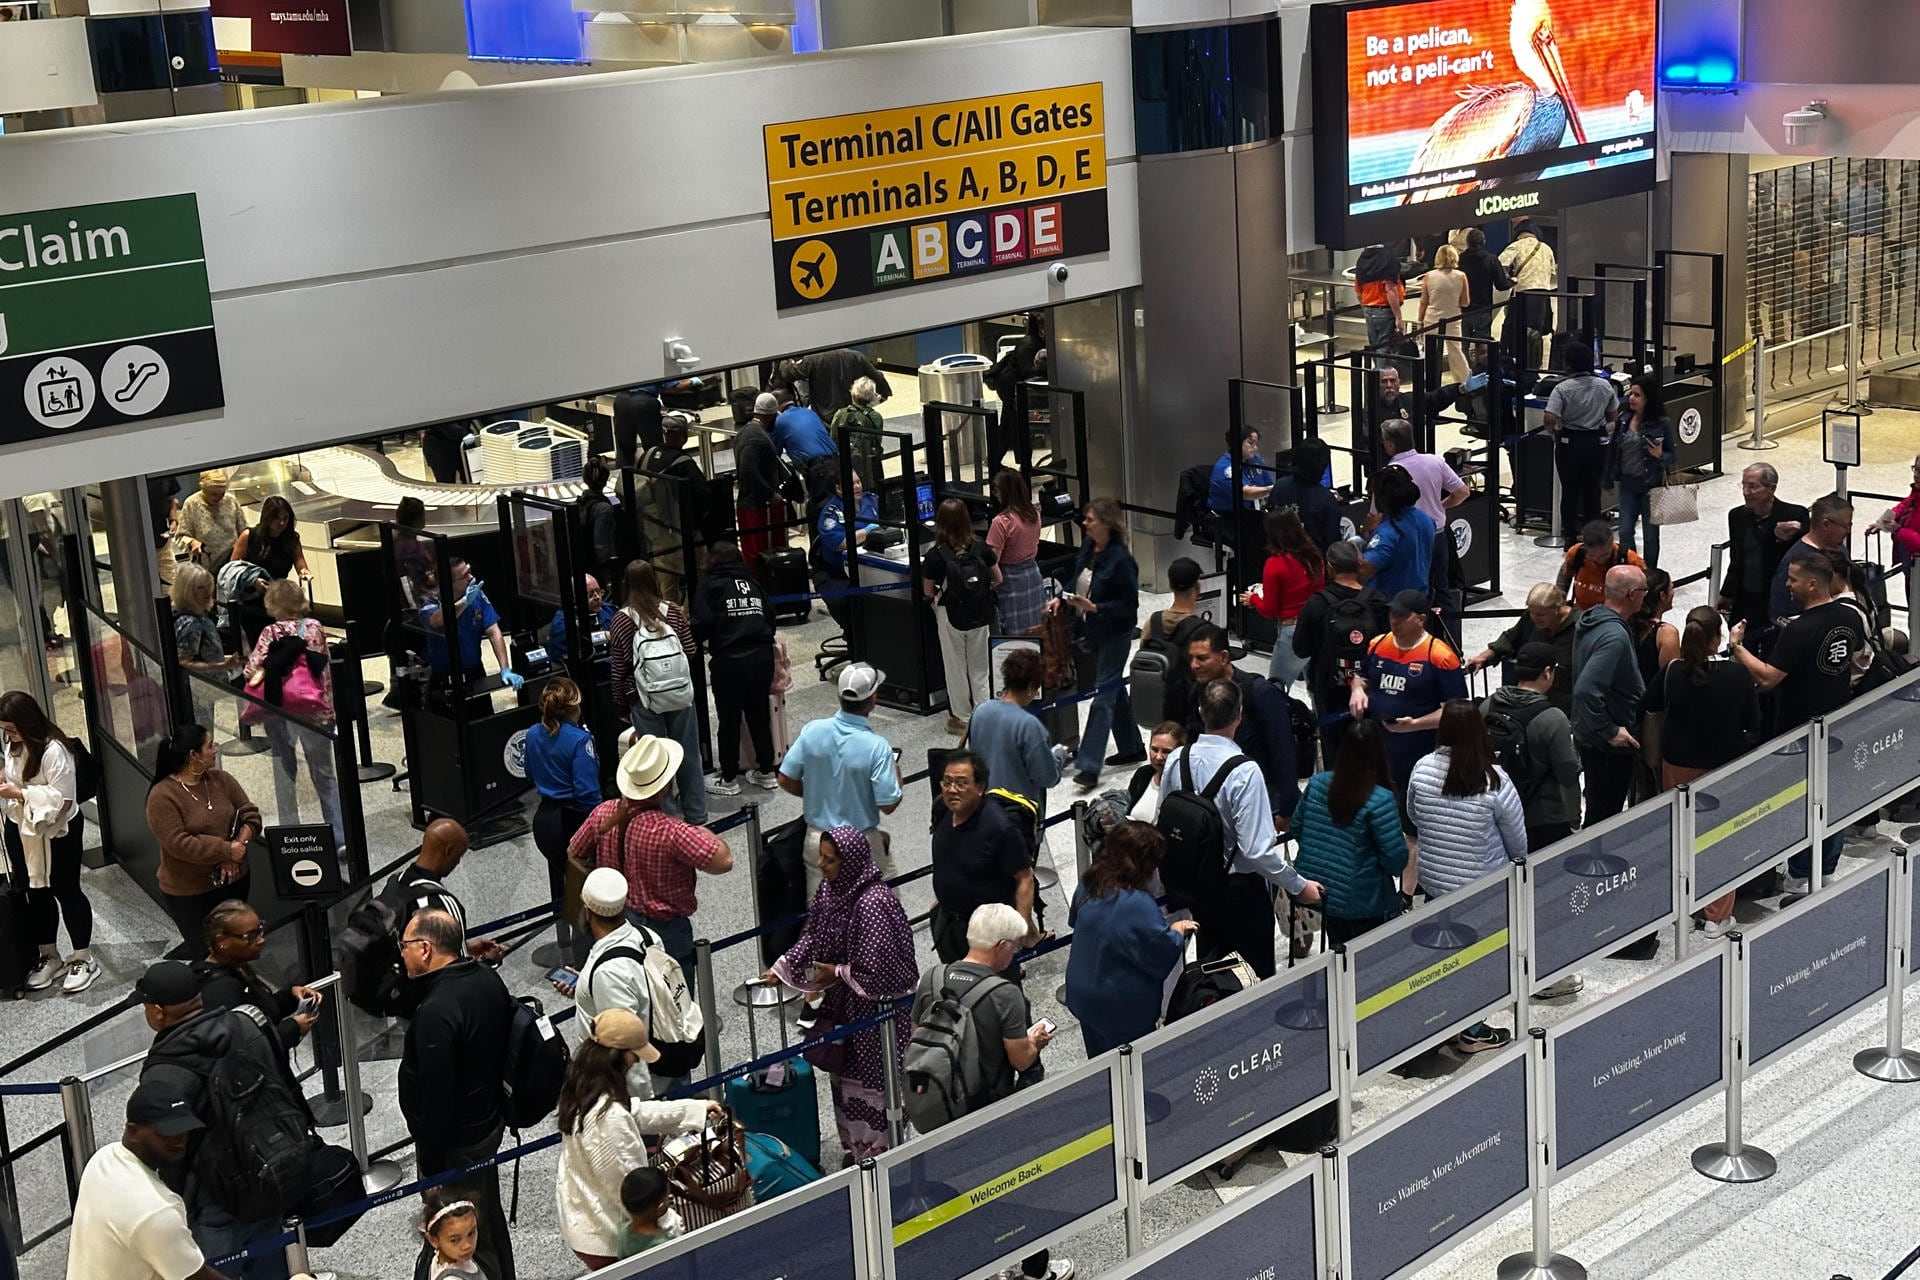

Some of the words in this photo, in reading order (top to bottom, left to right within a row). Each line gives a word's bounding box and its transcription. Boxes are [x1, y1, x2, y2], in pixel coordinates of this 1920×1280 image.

[270, 8, 329, 24] mays.tamu.edu/mba
[1366, 36, 1389, 56] Be
[1393, 37, 1404, 53] a
[1407, 26, 1473, 56] pelican,
[1367, 64, 1398, 87] not
[1401, 65, 1412, 82] a
[1415, 50, 1495, 85] peli-can't
[780, 116, 924, 168] Terminal
[932, 106, 1002, 148] C/All
[1010, 102, 1093, 136] Gates
[785, 171, 948, 226] Terminals
[958, 166, 989, 201] A,
[1000, 160, 1028, 195] B,
[1036, 155, 1066, 189] D,
[1075, 149, 1092, 181] E
[1475, 191, 1540, 217] JCDecaux
[955, 219, 983, 258] C
[994, 213, 1021, 252] D
[1033, 206, 1057, 246] E
[0, 220, 131, 271] Claim
[876, 233, 906, 273] A
[916, 226, 944, 266] B
[995, 251, 1023, 262] TERMINAL
[1033, 244, 1061, 255] TERMINAL
[877, 273, 907, 284] TERMINAL
[956, 258, 986, 269] TERMINAL
[726, 598, 737, 609] SET
[1872, 728, 1904, 754] CLEAR
[300, 835, 317, 843] only
[300, 845, 323, 853] salida
[1596, 866, 1637, 896] CLEAR
[1408, 968, 1441, 990] Welcome
[1442, 957, 1460, 974] Back
[1228, 1043, 1282, 1080] CLEAR
[1265, 1059, 1283, 1073] PLUS
[1593, 1072, 1611, 1088] Less
[1611, 1055, 1643, 1078] Waiting,
[1643, 1044, 1663, 1062] More
[1663, 1031, 1687, 1050] Doing
[970, 1176, 1017, 1206] Welcome
[1018, 1163, 1043, 1183] Back
[1378, 1196, 1397, 1215] Less
[1398, 1175, 1431, 1202] Waiting,
[1432, 1160, 1453, 1182] More
[1453, 1131, 1502, 1169] Adventuring
[214, 1254, 241, 1266] UNITED
